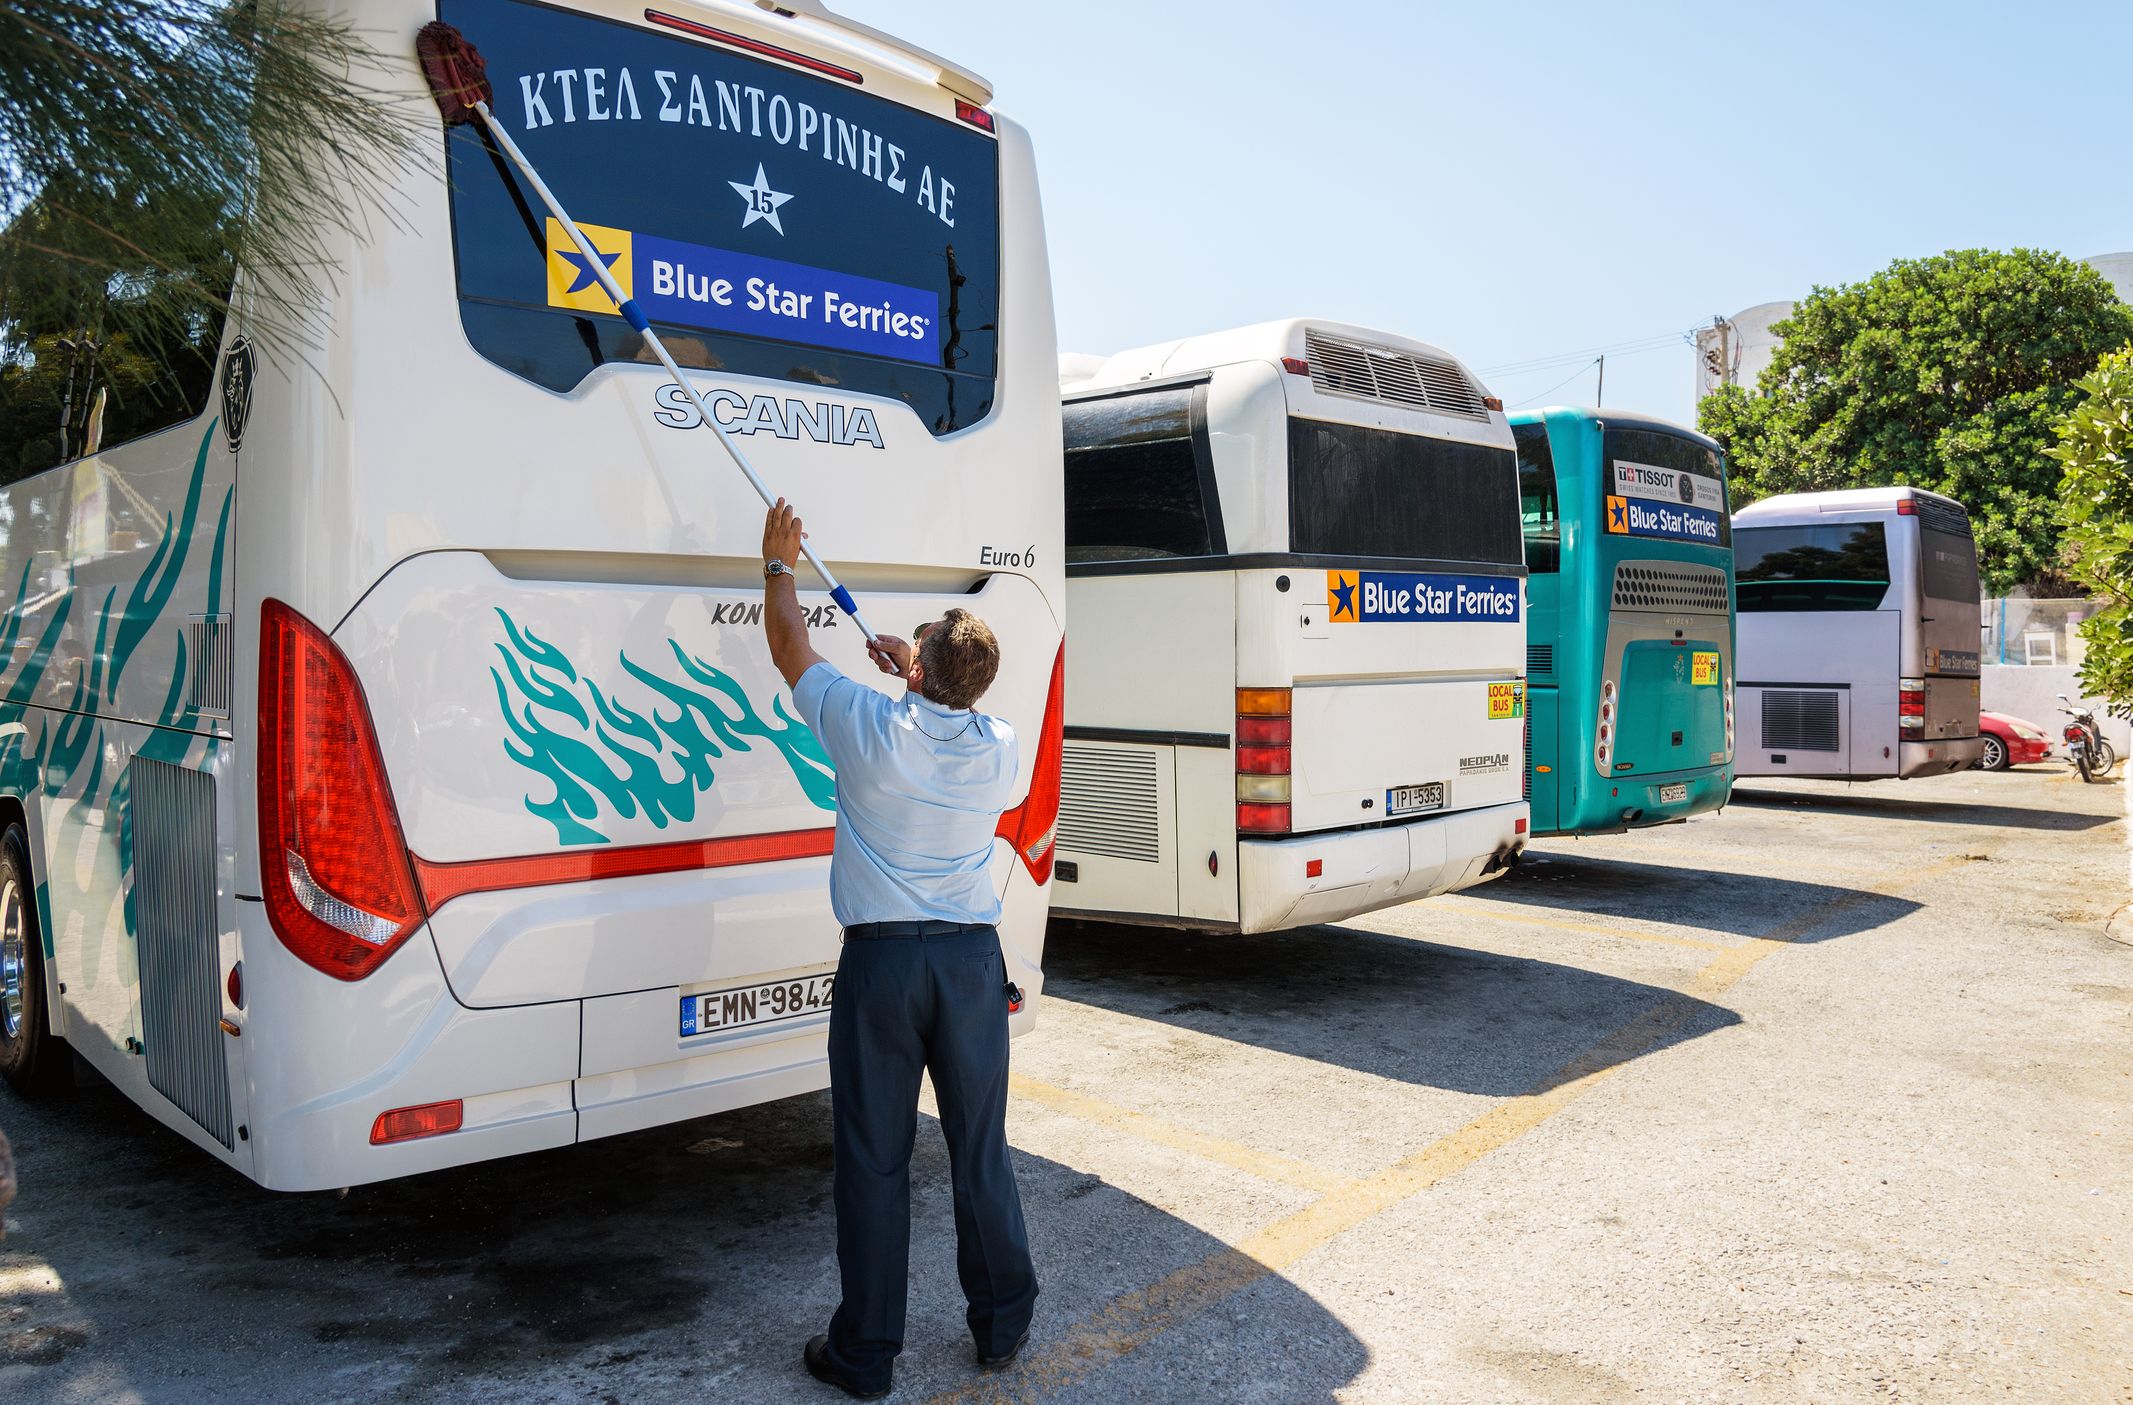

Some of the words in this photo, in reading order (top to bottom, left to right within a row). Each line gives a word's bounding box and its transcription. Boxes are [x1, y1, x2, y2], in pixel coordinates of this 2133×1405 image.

[518, 67, 642, 130] ΚΤΕΛ
[653, 69, 907, 195] ΣΑΝΤΟΡΙΝΗΣ
[916, 164, 956, 229] ΑΕ
[749, 189, 774, 214] 15
[651, 259, 733, 307] Blue
[746, 276, 814, 320] Star
[824, 290, 926, 341] Ferries
[653, 383, 886, 449] SCANIA
[1635, 468, 1674, 489] TISSOT
[1629, 505, 1658, 530] Blue
[1659, 508, 1682, 533] Star
[1684, 512, 1716, 538] Ferries
[979, 545, 1021, 567] Euro
[1023, 544, 1035, 569] 6
[1363, 582, 1411, 615] Blue
[1414, 582, 1453, 615] Star
[1456, 584, 1515, 616] Ferries
[1693, 655, 1710, 665] LOCAL
[1940, 655, 1952, 669] Blue
[1952, 655, 1962, 670] Star
[1695, 667, 1707, 678] BUS
[1488, 685, 1513, 698] LOCAL
[1493, 699, 1509, 711] BUS
[1459, 753, 1509, 768] NEOPLAN
[682, 1020, 695, 1029] GR
